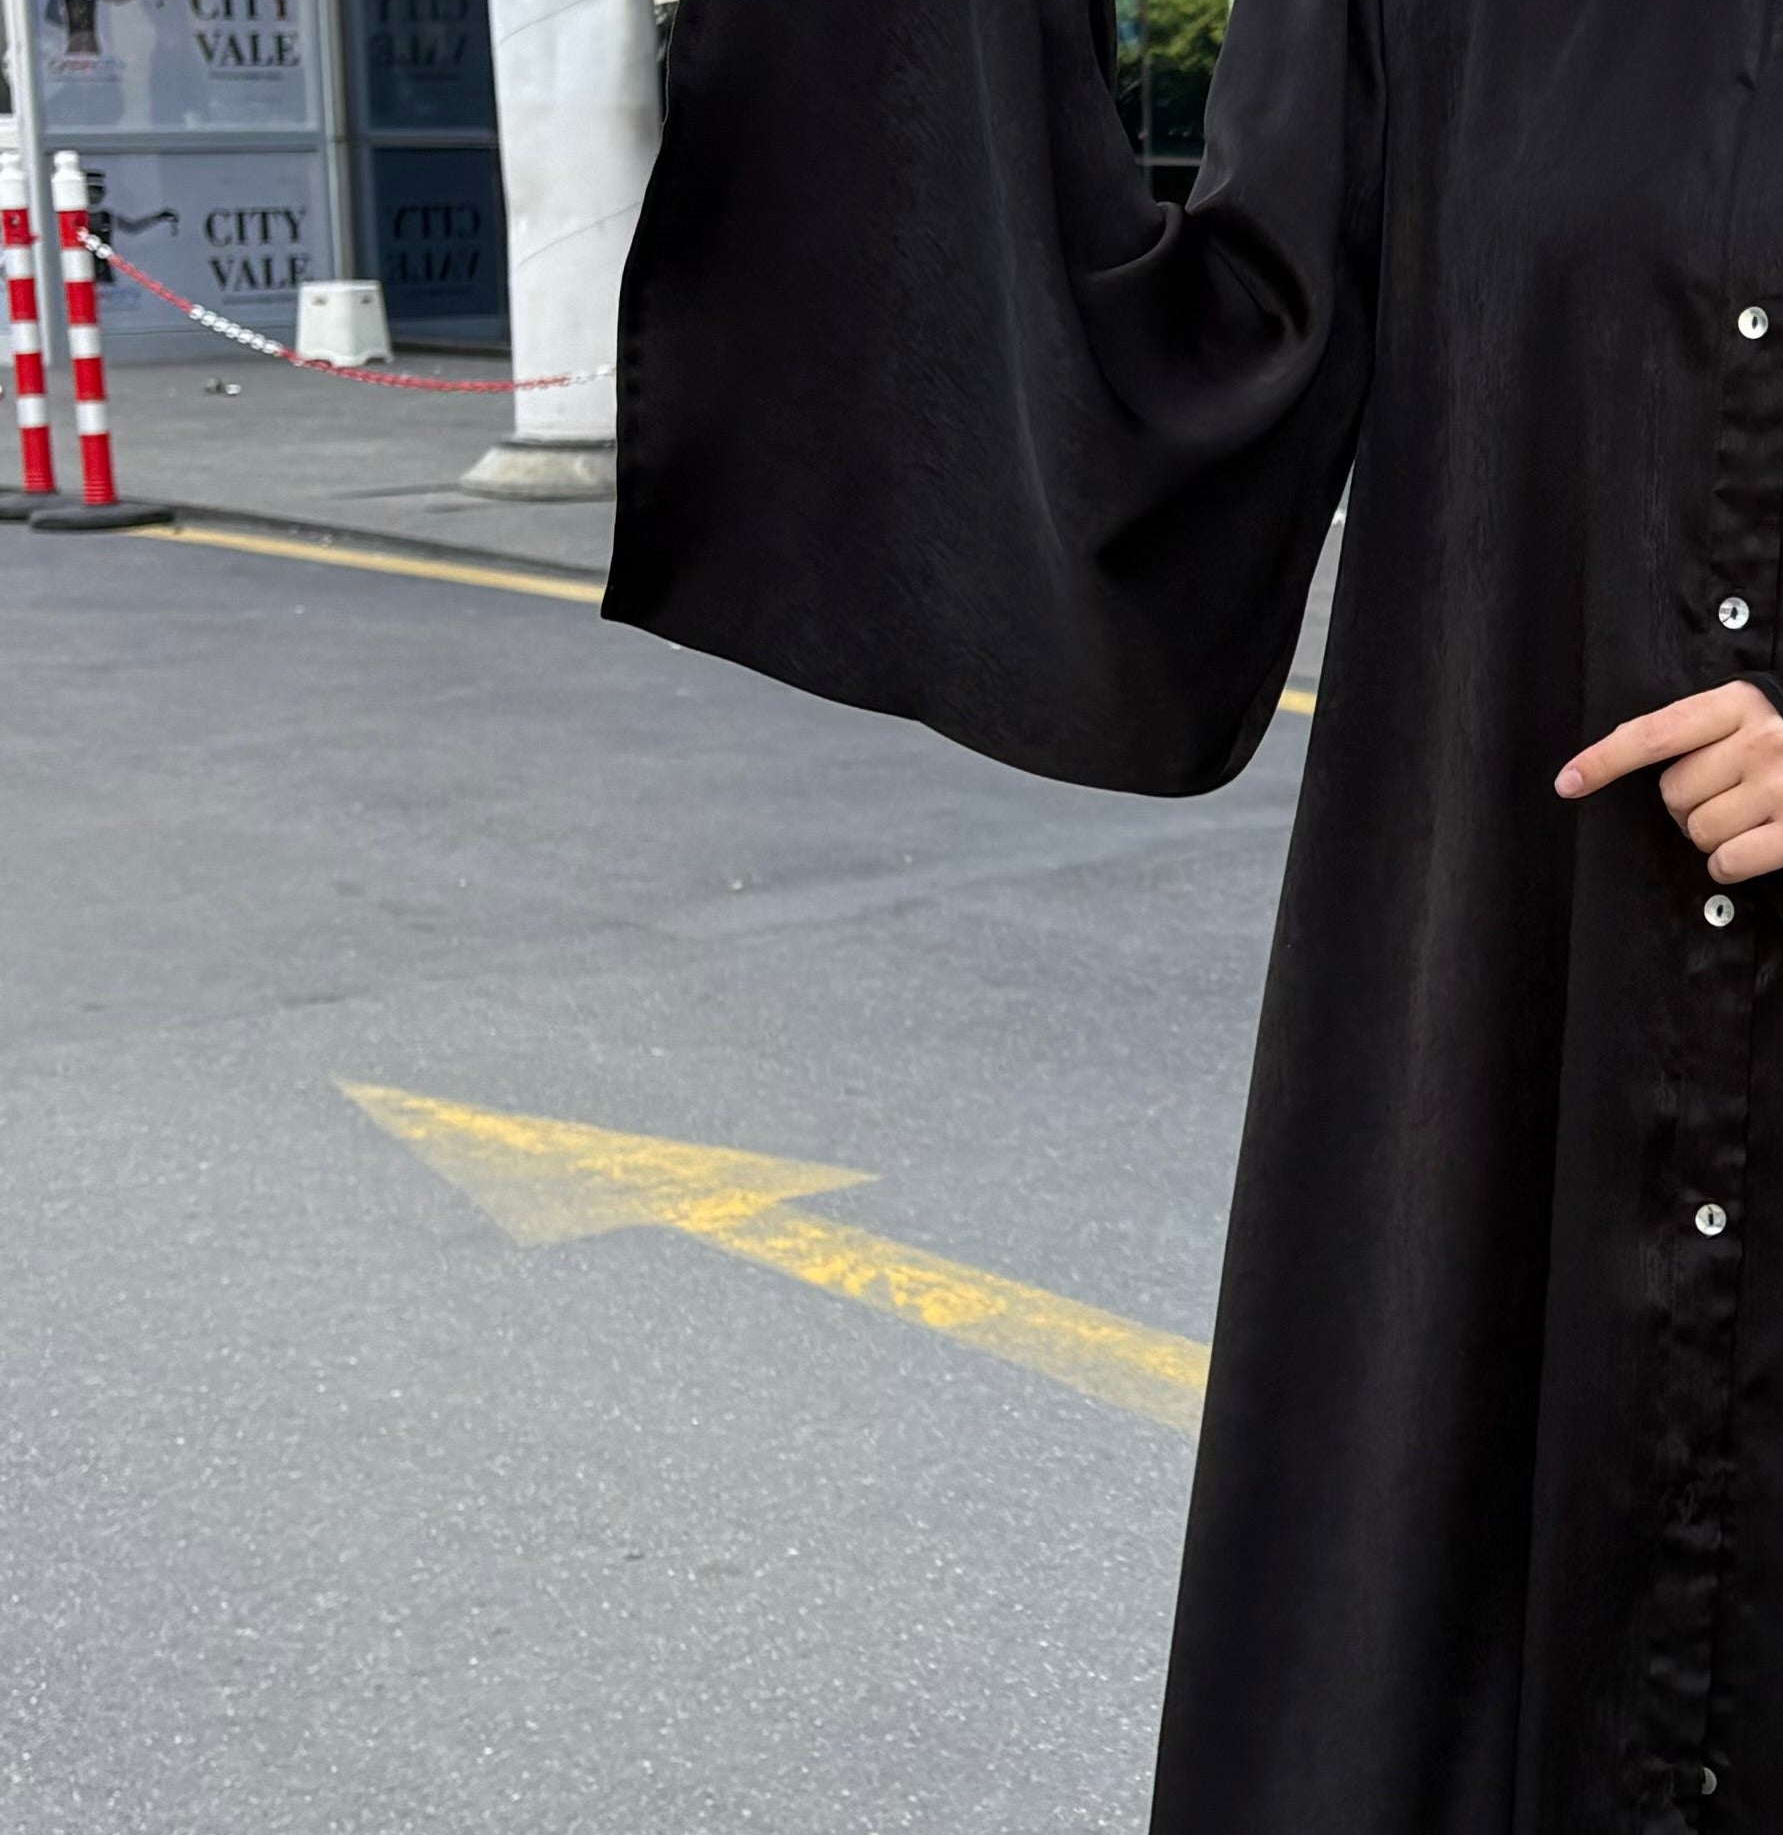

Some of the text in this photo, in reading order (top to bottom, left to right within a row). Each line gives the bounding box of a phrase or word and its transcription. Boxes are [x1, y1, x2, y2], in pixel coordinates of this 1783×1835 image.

[194, 29, 300, 66] VALE
[203, 206, 307, 246] CITY
[208, 252, 314, 292] VALE
